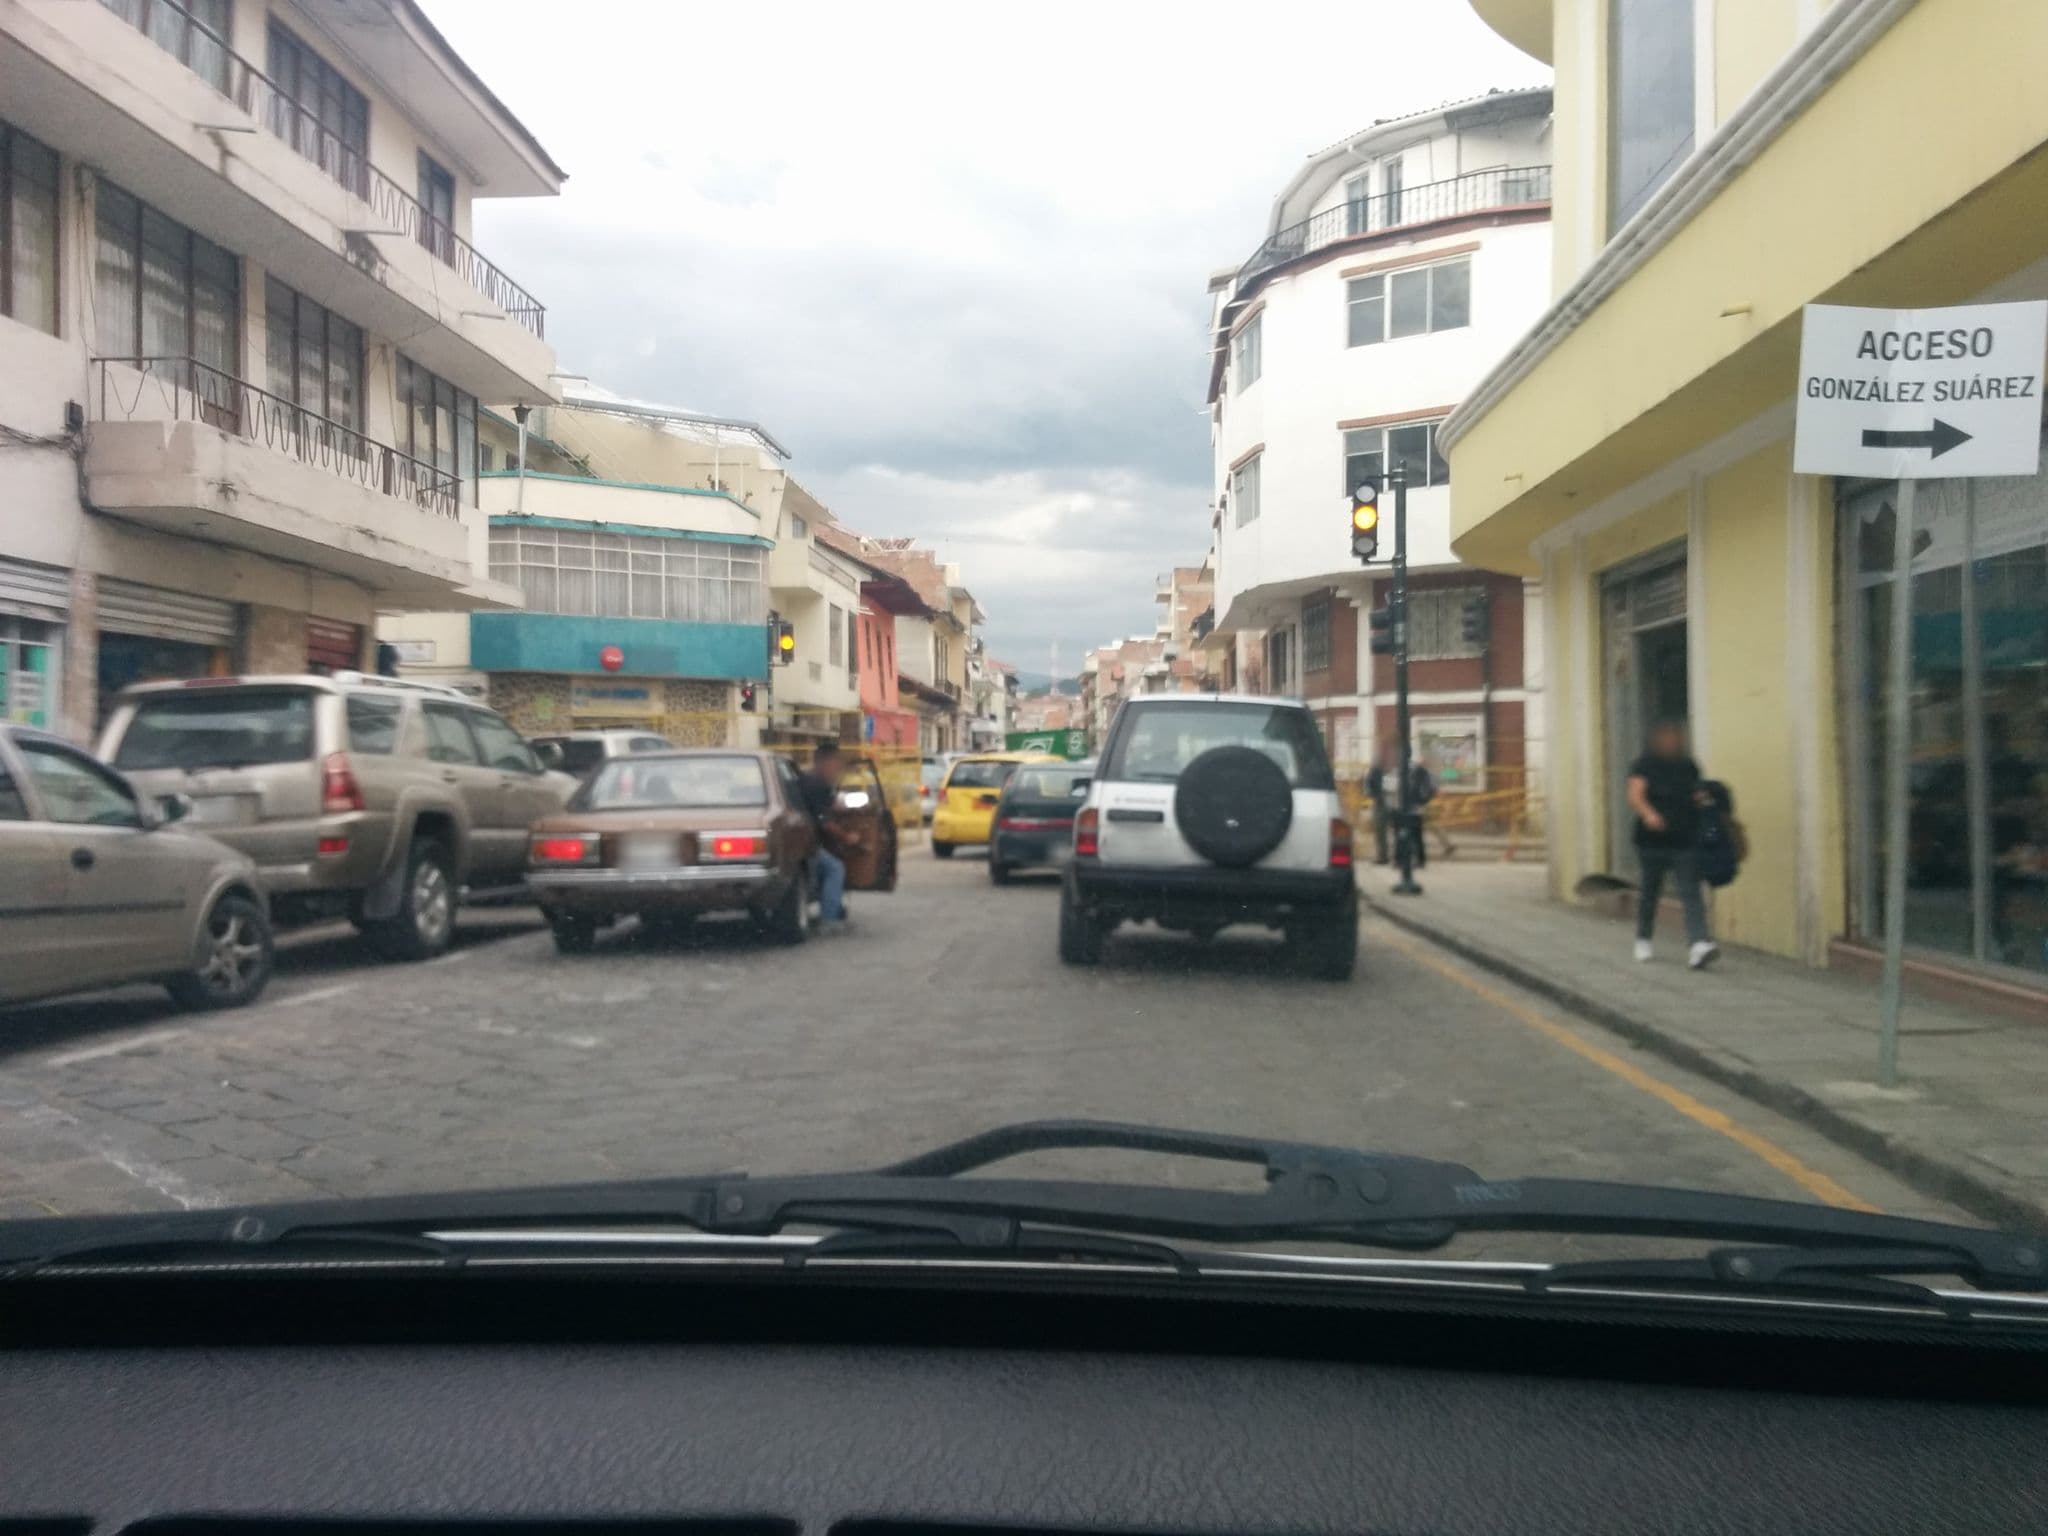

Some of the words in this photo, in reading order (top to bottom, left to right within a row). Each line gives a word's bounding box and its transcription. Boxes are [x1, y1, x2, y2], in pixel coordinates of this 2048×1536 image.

[1856, 327, 1993, 361] ACCESO
[1806, 376, 1925, 403] GONZÁLEZ
[1932, 374, 2036, 402] SUÁREZ
